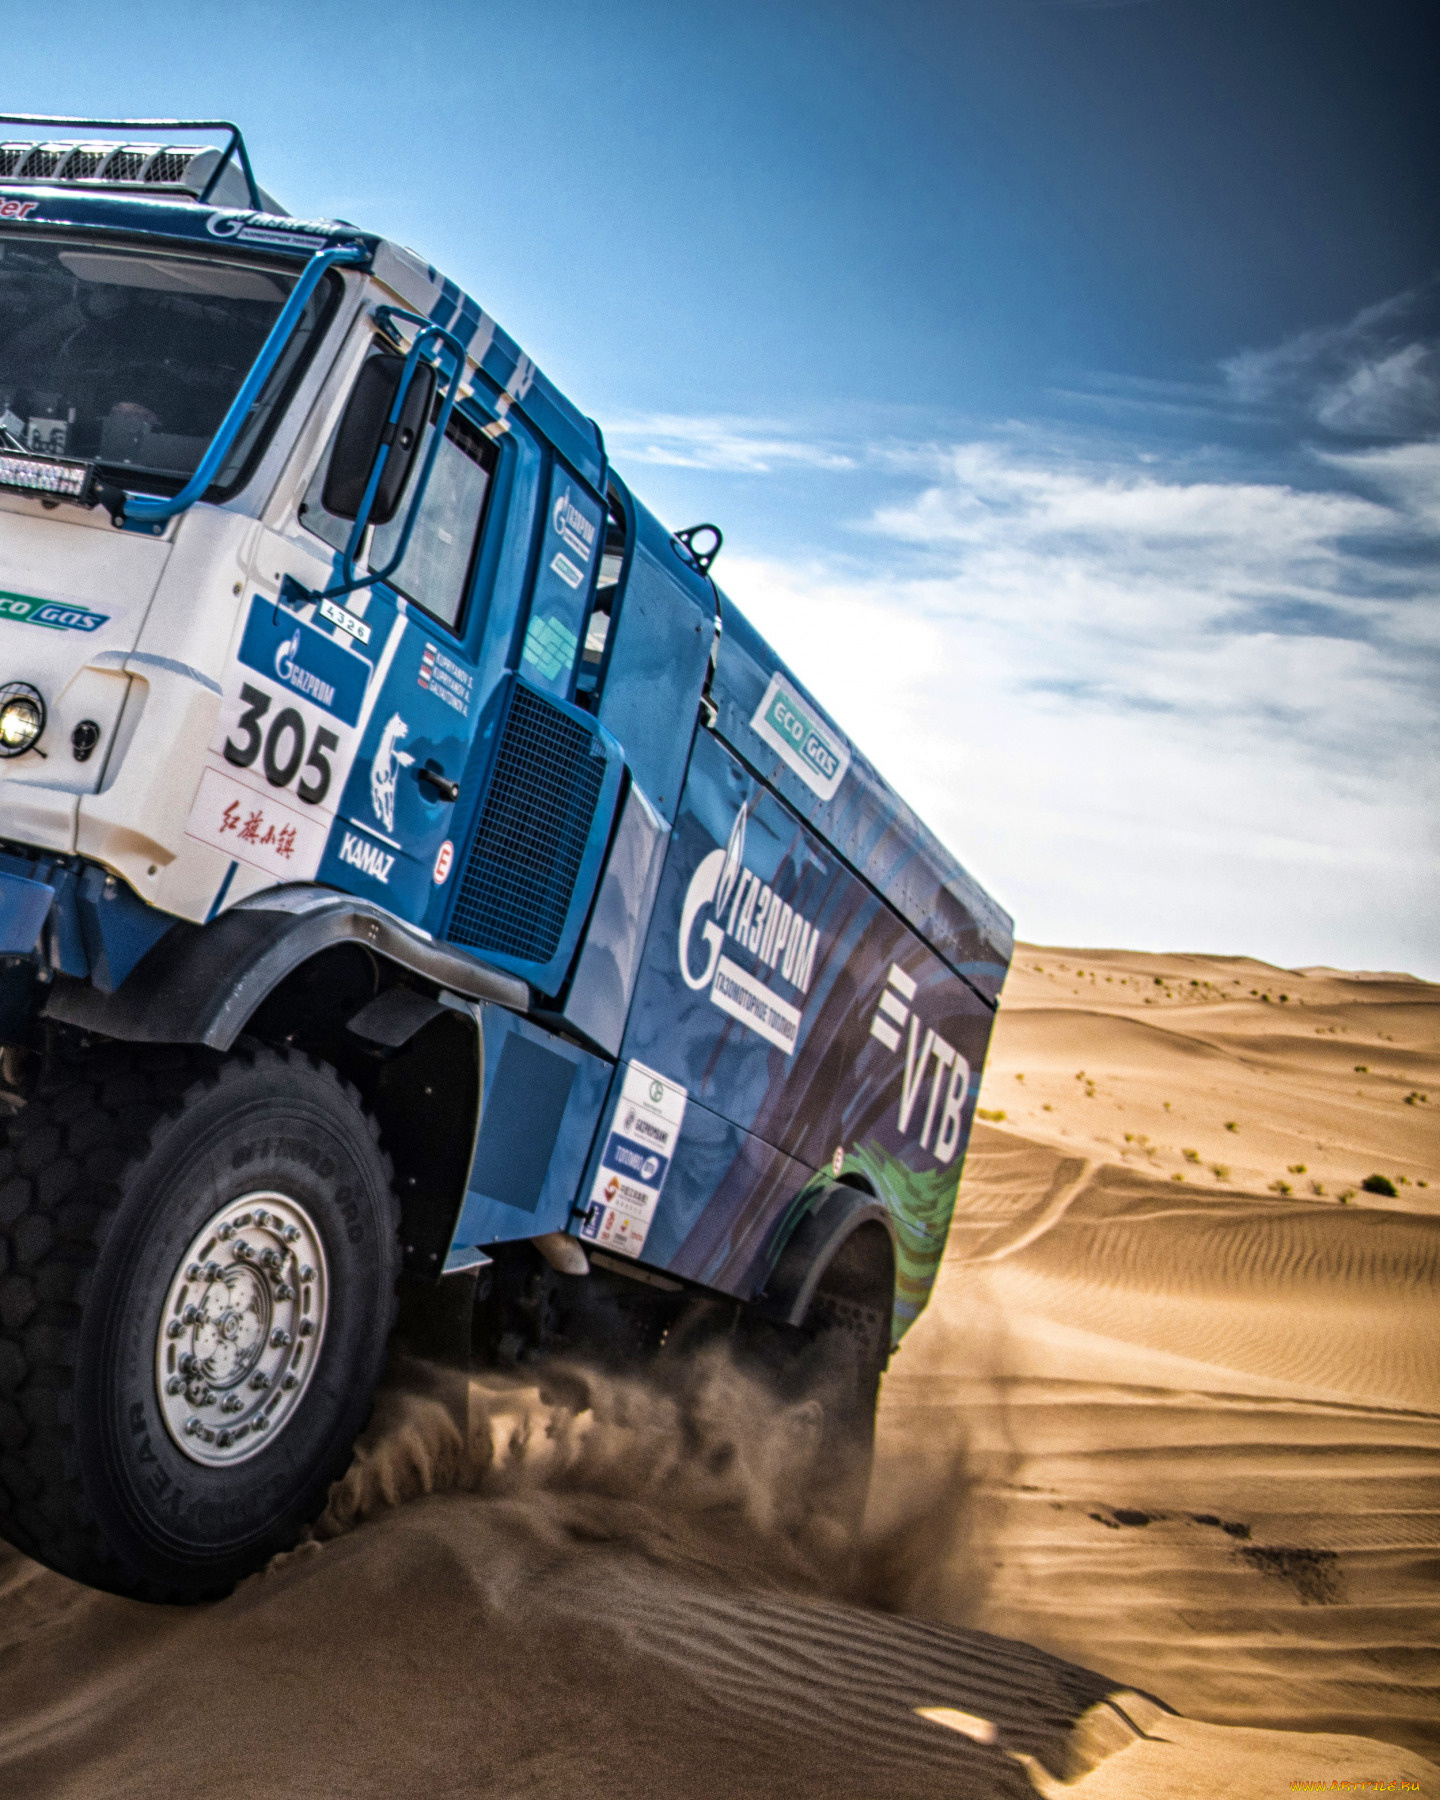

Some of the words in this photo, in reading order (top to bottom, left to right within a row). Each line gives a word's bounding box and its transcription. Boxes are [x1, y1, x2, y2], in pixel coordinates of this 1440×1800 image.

[223, 681, 341, 805] 305
[290, 663, 336, 707] GAZPROM
[338, 832, 396, 884] KAMAZ
[726, 866, 820, 995] ГАЗПРОМ
[897, 1013, 971, 1164] VTB
